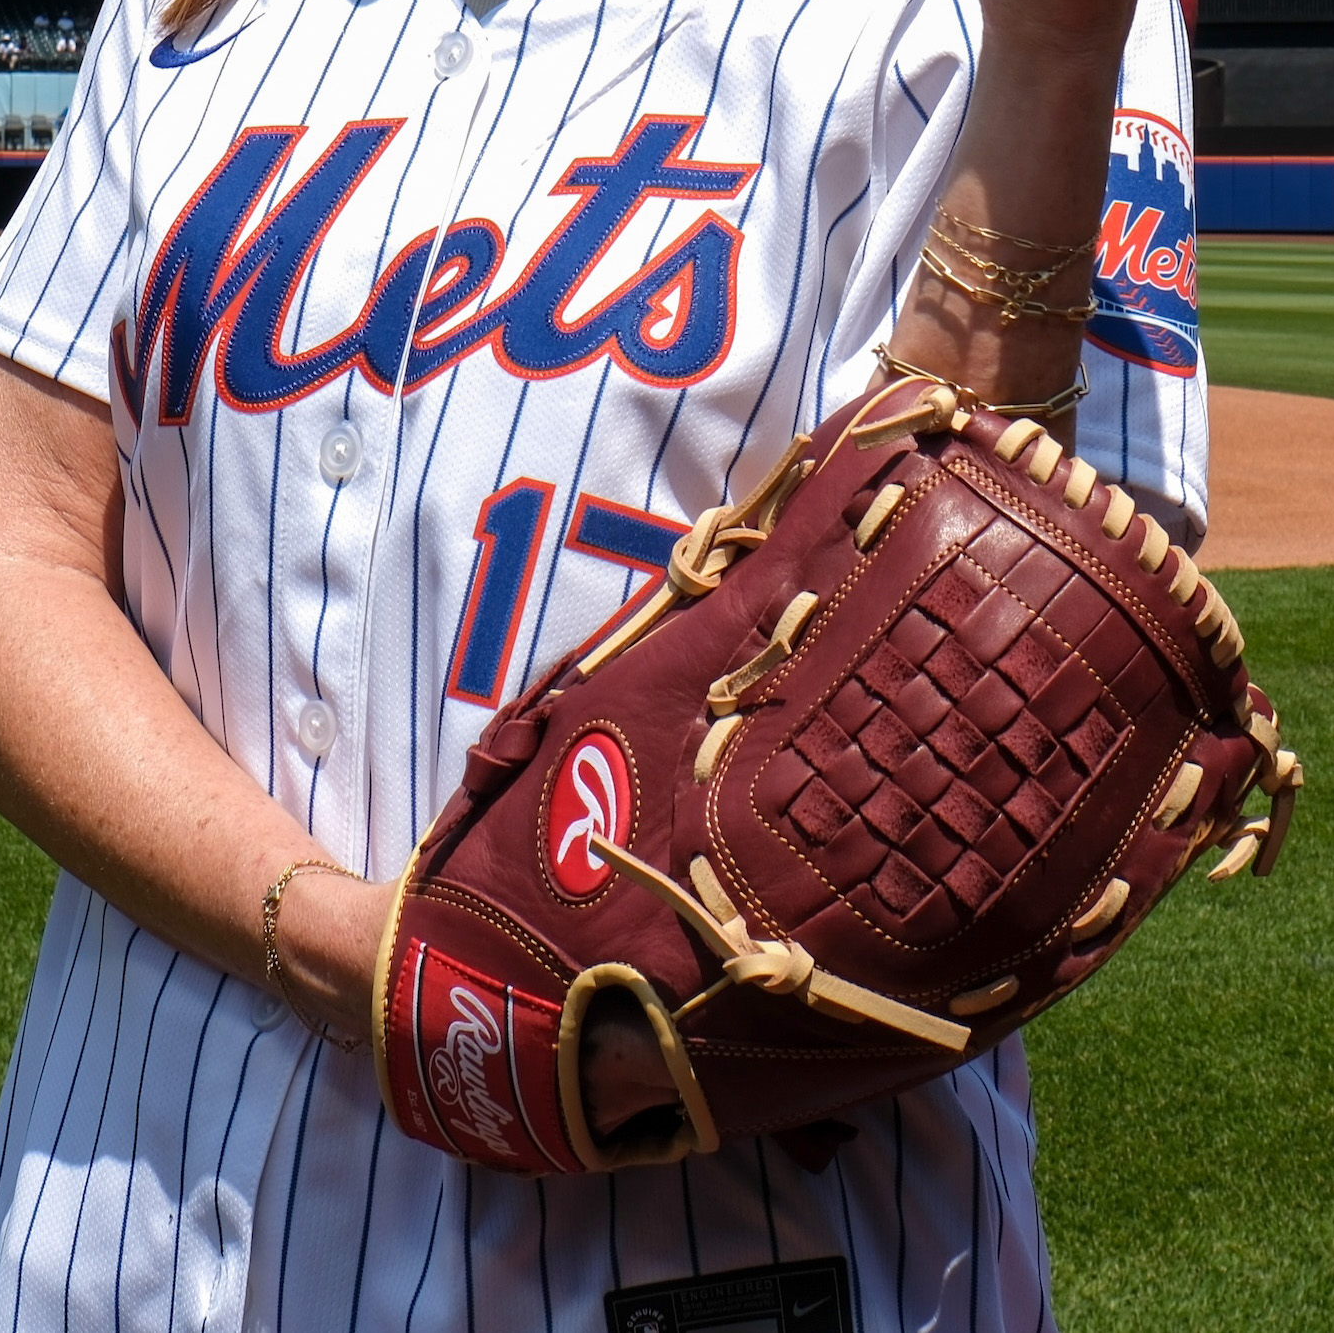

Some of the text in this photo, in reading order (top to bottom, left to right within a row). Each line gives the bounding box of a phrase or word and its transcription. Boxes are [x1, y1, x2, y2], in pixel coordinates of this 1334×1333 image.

[111, 114, 761, 427] Mets
[446, 476, 693, 708] 17
[447, 986, 519, 1157] Rawlings
[680, 1279, 774, 1304] ENGINEERED
